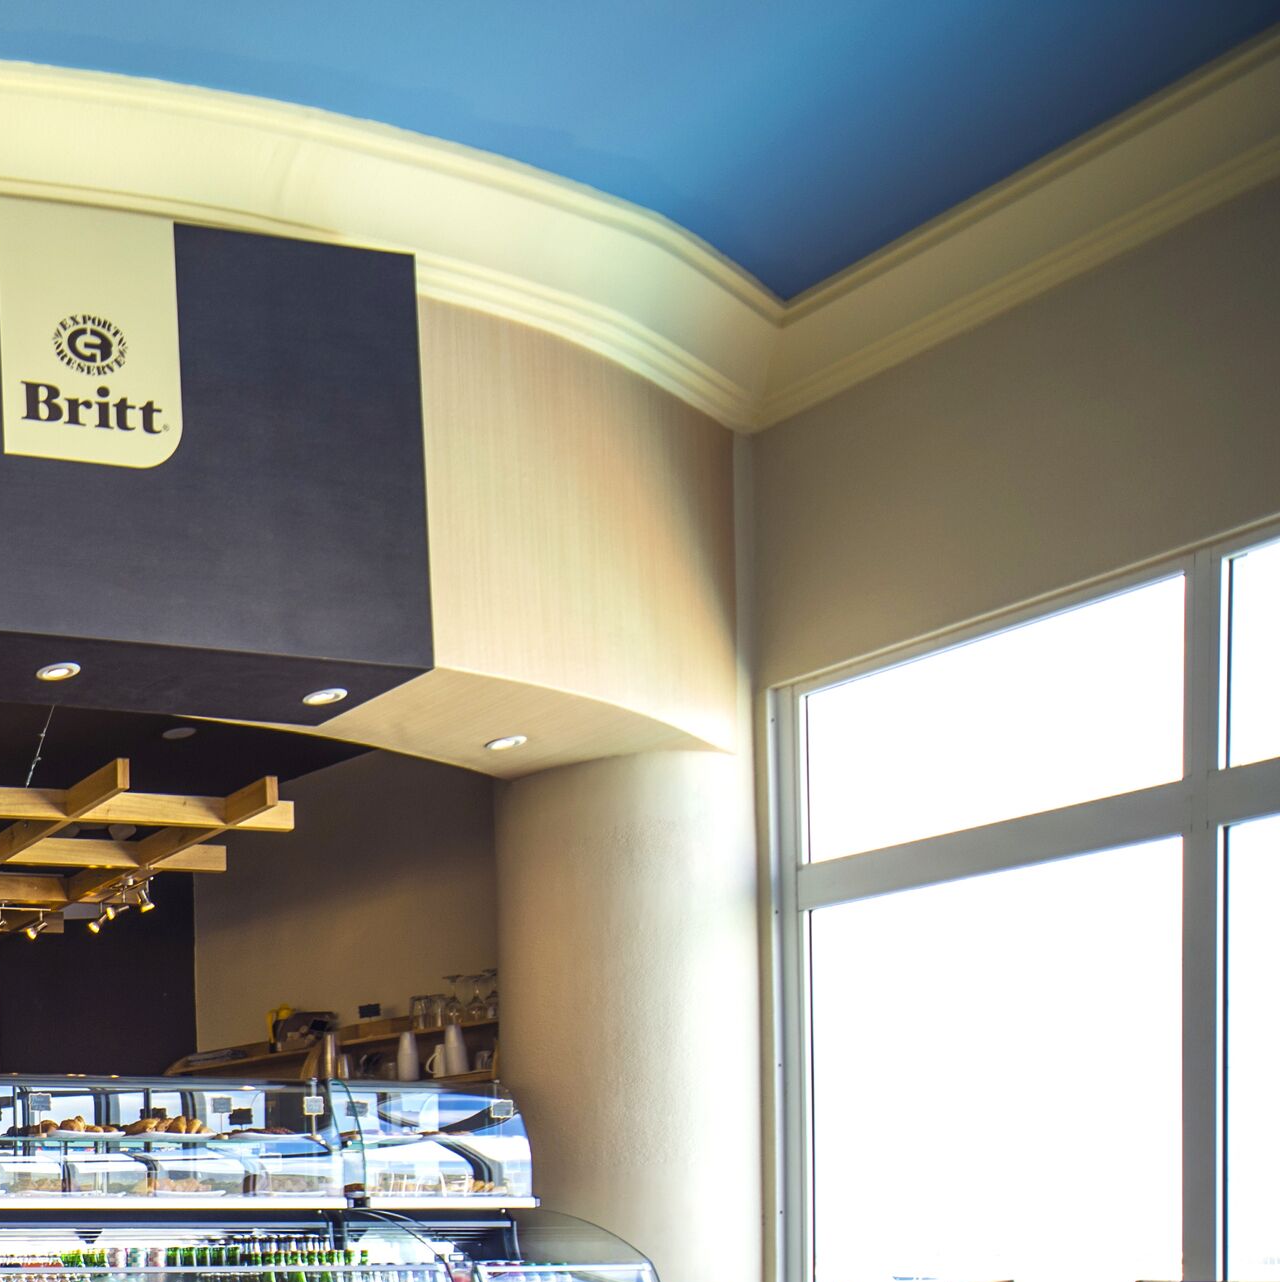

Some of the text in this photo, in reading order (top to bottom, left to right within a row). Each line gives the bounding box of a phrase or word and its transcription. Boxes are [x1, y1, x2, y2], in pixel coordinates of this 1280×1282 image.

[59, 314, 123, 340] EXPORT
[55, 347, 126, 376] RESERVE
[20, 380, 163, 435] Britt
